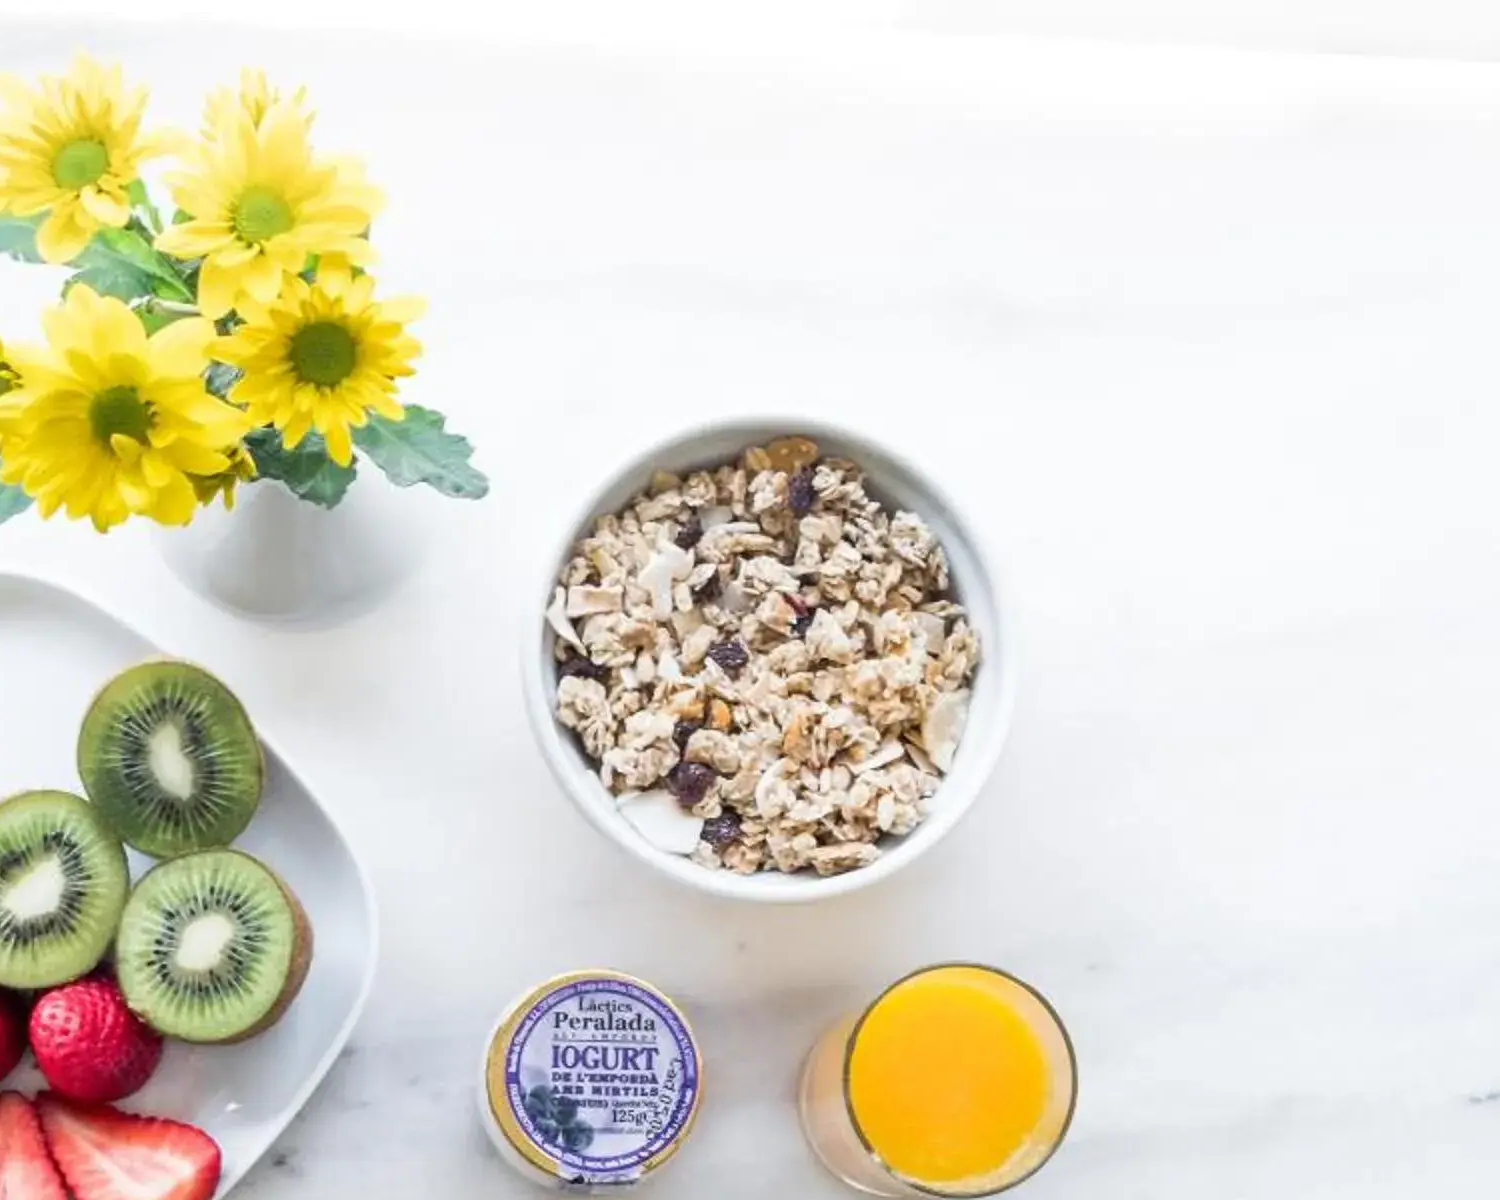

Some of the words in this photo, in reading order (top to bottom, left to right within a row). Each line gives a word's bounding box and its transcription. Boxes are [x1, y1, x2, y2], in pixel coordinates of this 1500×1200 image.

[553, 1011, 656, 1032] Peralada
[552, 1045, 660, 1071] IOGURT
[552, 1072, 572, 1083] DE
[591, 1084, 660, 1097] MIRTILS
